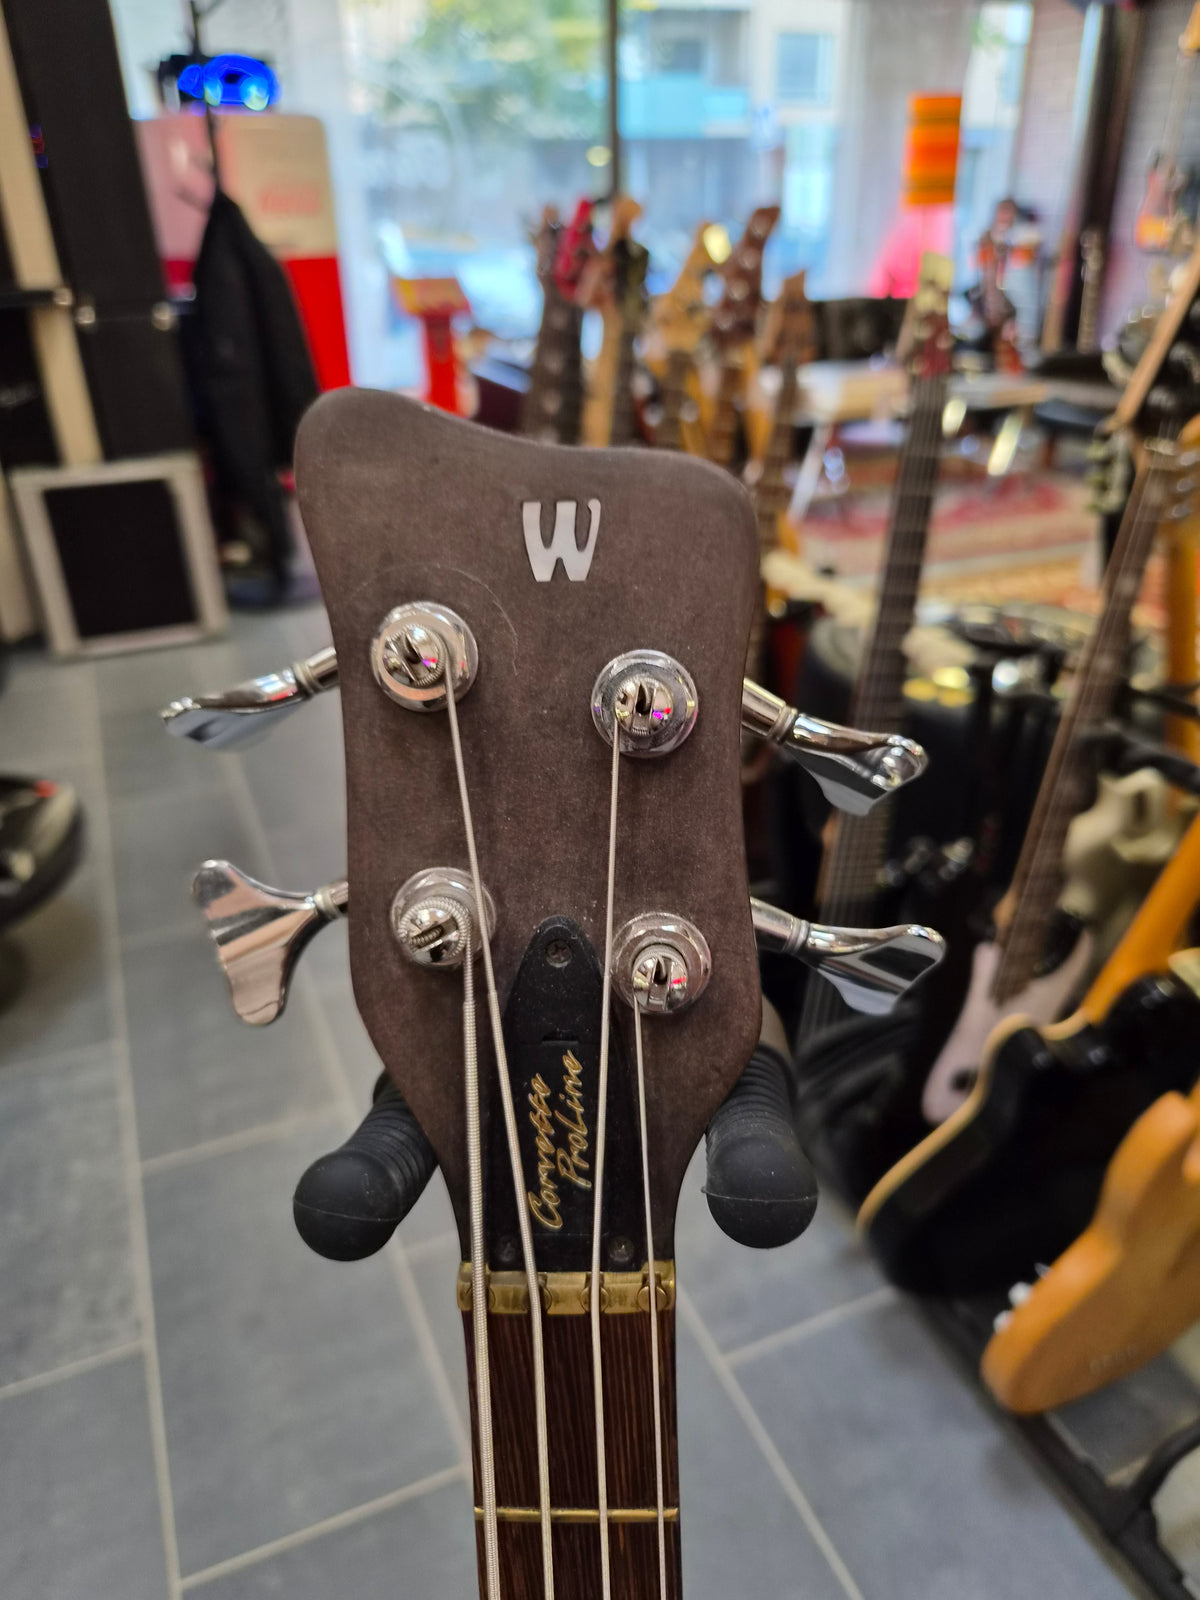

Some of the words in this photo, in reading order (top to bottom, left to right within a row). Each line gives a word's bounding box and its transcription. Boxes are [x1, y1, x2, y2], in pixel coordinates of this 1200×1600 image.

[522, 499, 601, 582] W
[527, 1073, 563, 1228] Corvette
[554, 1050, 592, 1188] ProLine
